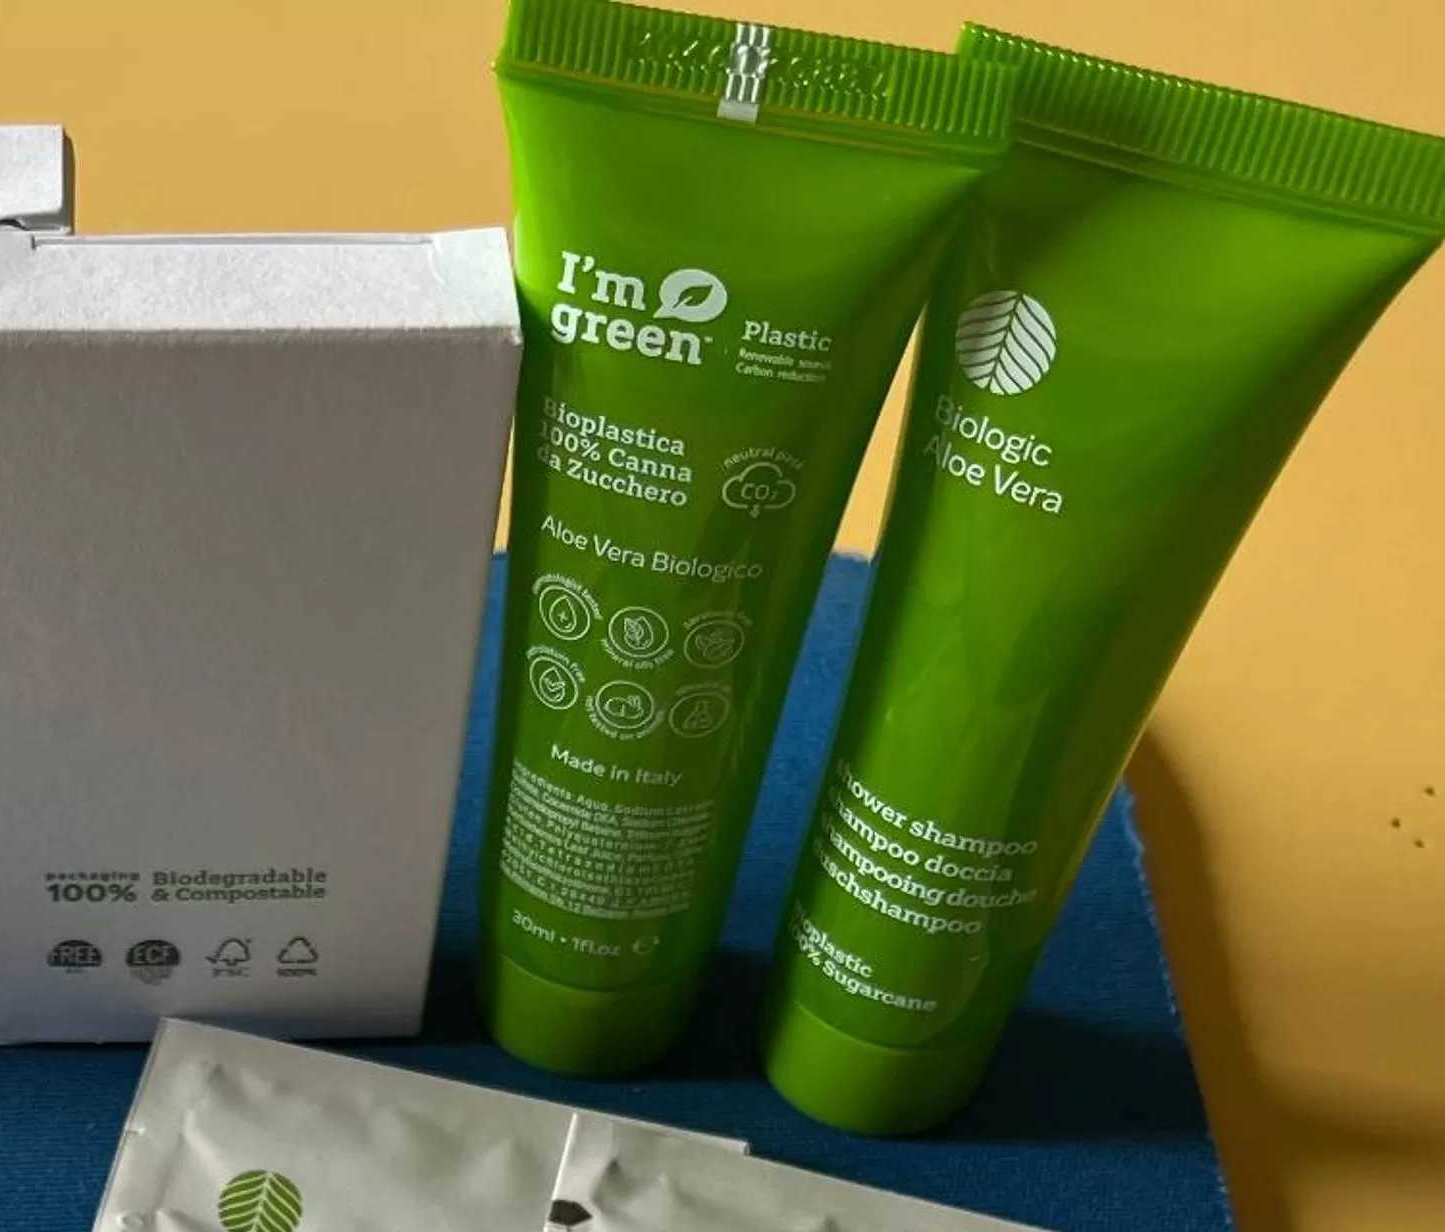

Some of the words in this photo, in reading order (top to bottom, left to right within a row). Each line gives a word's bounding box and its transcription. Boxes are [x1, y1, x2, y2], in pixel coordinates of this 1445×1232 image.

[558, 252, 645, 311] I'm
[551, 302, 702, 366] green
[741, 320, 832, 352] Plastic
[540, 421, 602, 463] 100%
[608, 448, 692, 483] Canna
[544, 397, 685, 456] Bioplastica
[934, 394, 1053, 466] Biologic
[537, 445, 562, 473] da
[567, 458, 688, 507] Zucchero
[924, 434, 986, 486] Aloe
[994, 464, 1063, 513] Vera
[541, 515, 588, 551] Aloe
[593, 535, 645, 569] Vera
[651, 551, 763, 584] Biologico
[550, 744, 605, 777] Made
[610, 765, 630, 782] in
[635, 768, 683, 787] Italy
[908, 820, 1038, 859] shampoo
[47, 884, 137, 903] 100%
[150, 888, 169, 901] &
[175, 886, 327, 904] Compostable
[152, 868, 327, 888] Biodegradable
[924, 855, 1013, 882] doccia
[512, 908, 555, 944] 30ml
[822, 959, 937, 1013] Sugarcane
